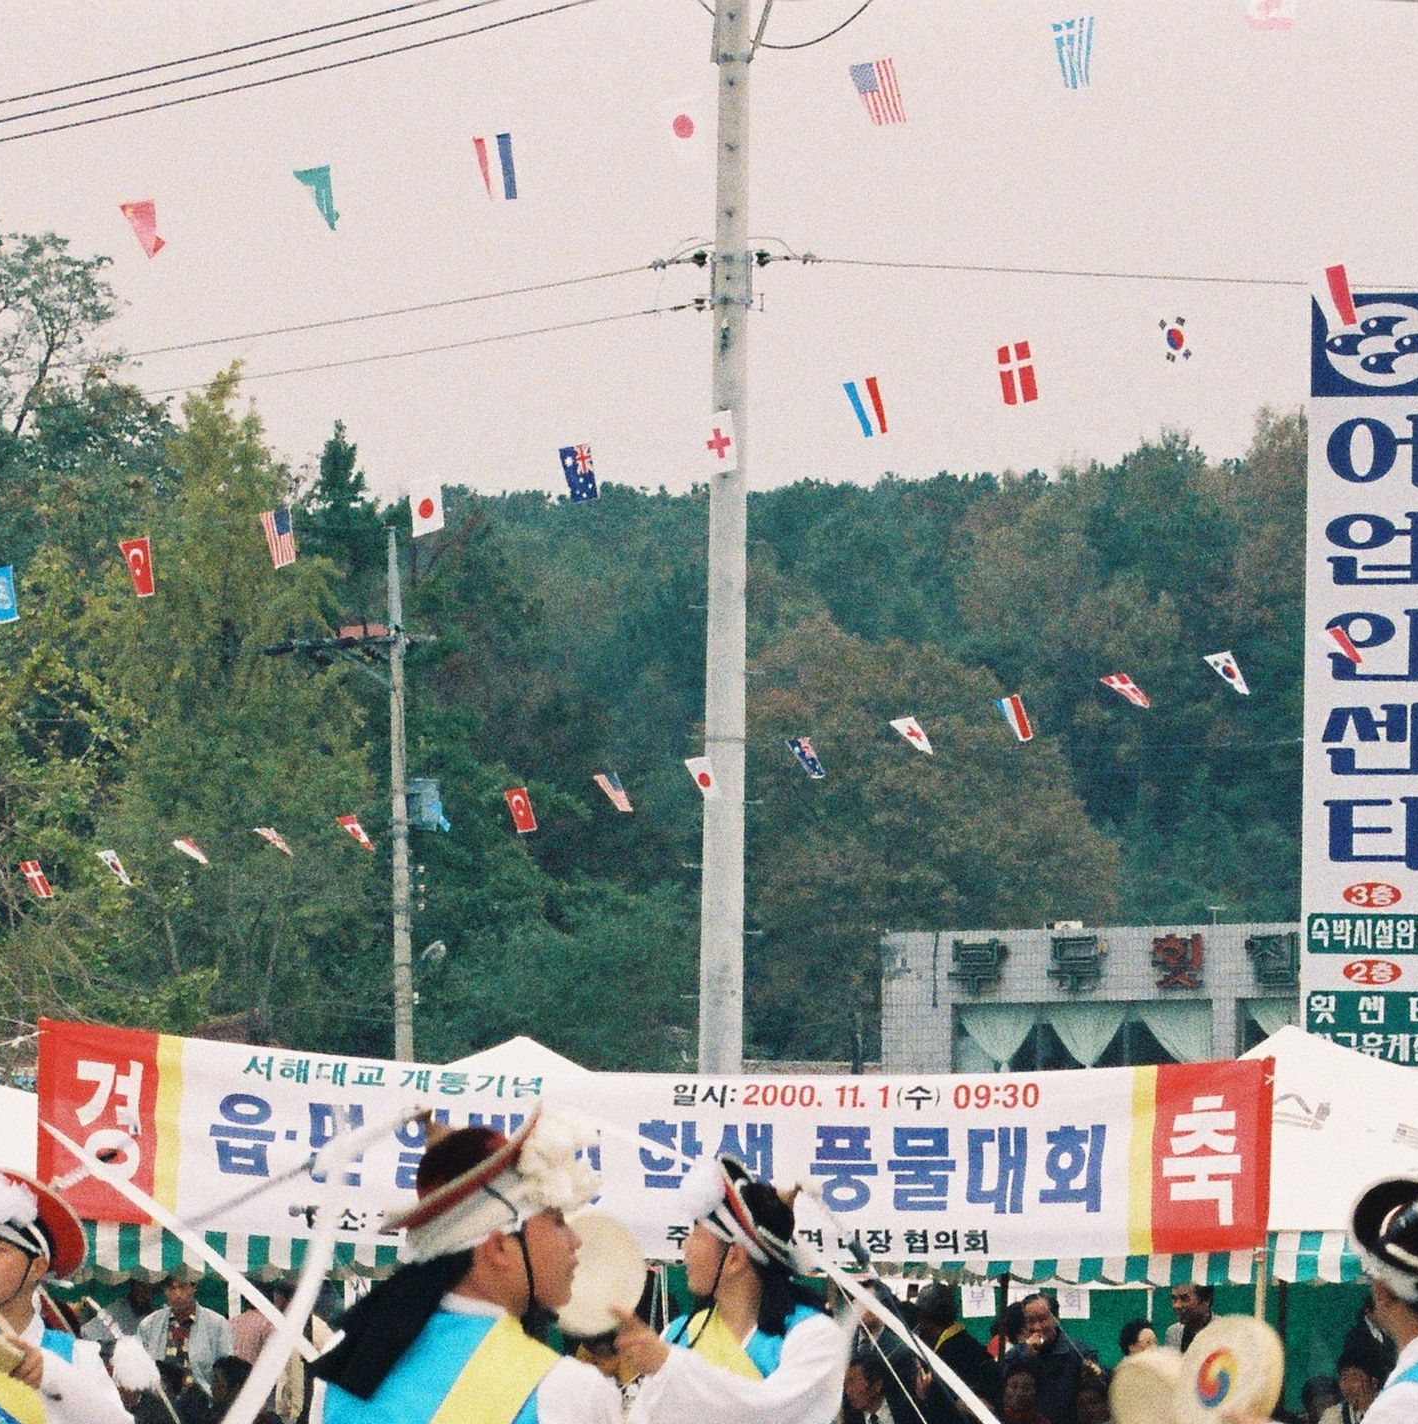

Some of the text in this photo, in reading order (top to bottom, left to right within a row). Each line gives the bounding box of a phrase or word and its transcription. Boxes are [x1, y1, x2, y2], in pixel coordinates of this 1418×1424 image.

[1350, 884, 1395, 905] 3층
[1350, 962, 1395, 981] 2층
[243, 1055, 544, 1099] 서해대교 개통기념
[672, 1083, 737, 1109] 일시:
[743, 1083, 823, 1108] 2000.
[953, 1082, 1040, 1108] 09:30
[75, 1058, 144, 1184] 경
[810, 1122, 1108, 1215] 풍물대회
[1162, 1095, 1242, 1227] 축
[904, 1228, 991, 1254] 협의회
